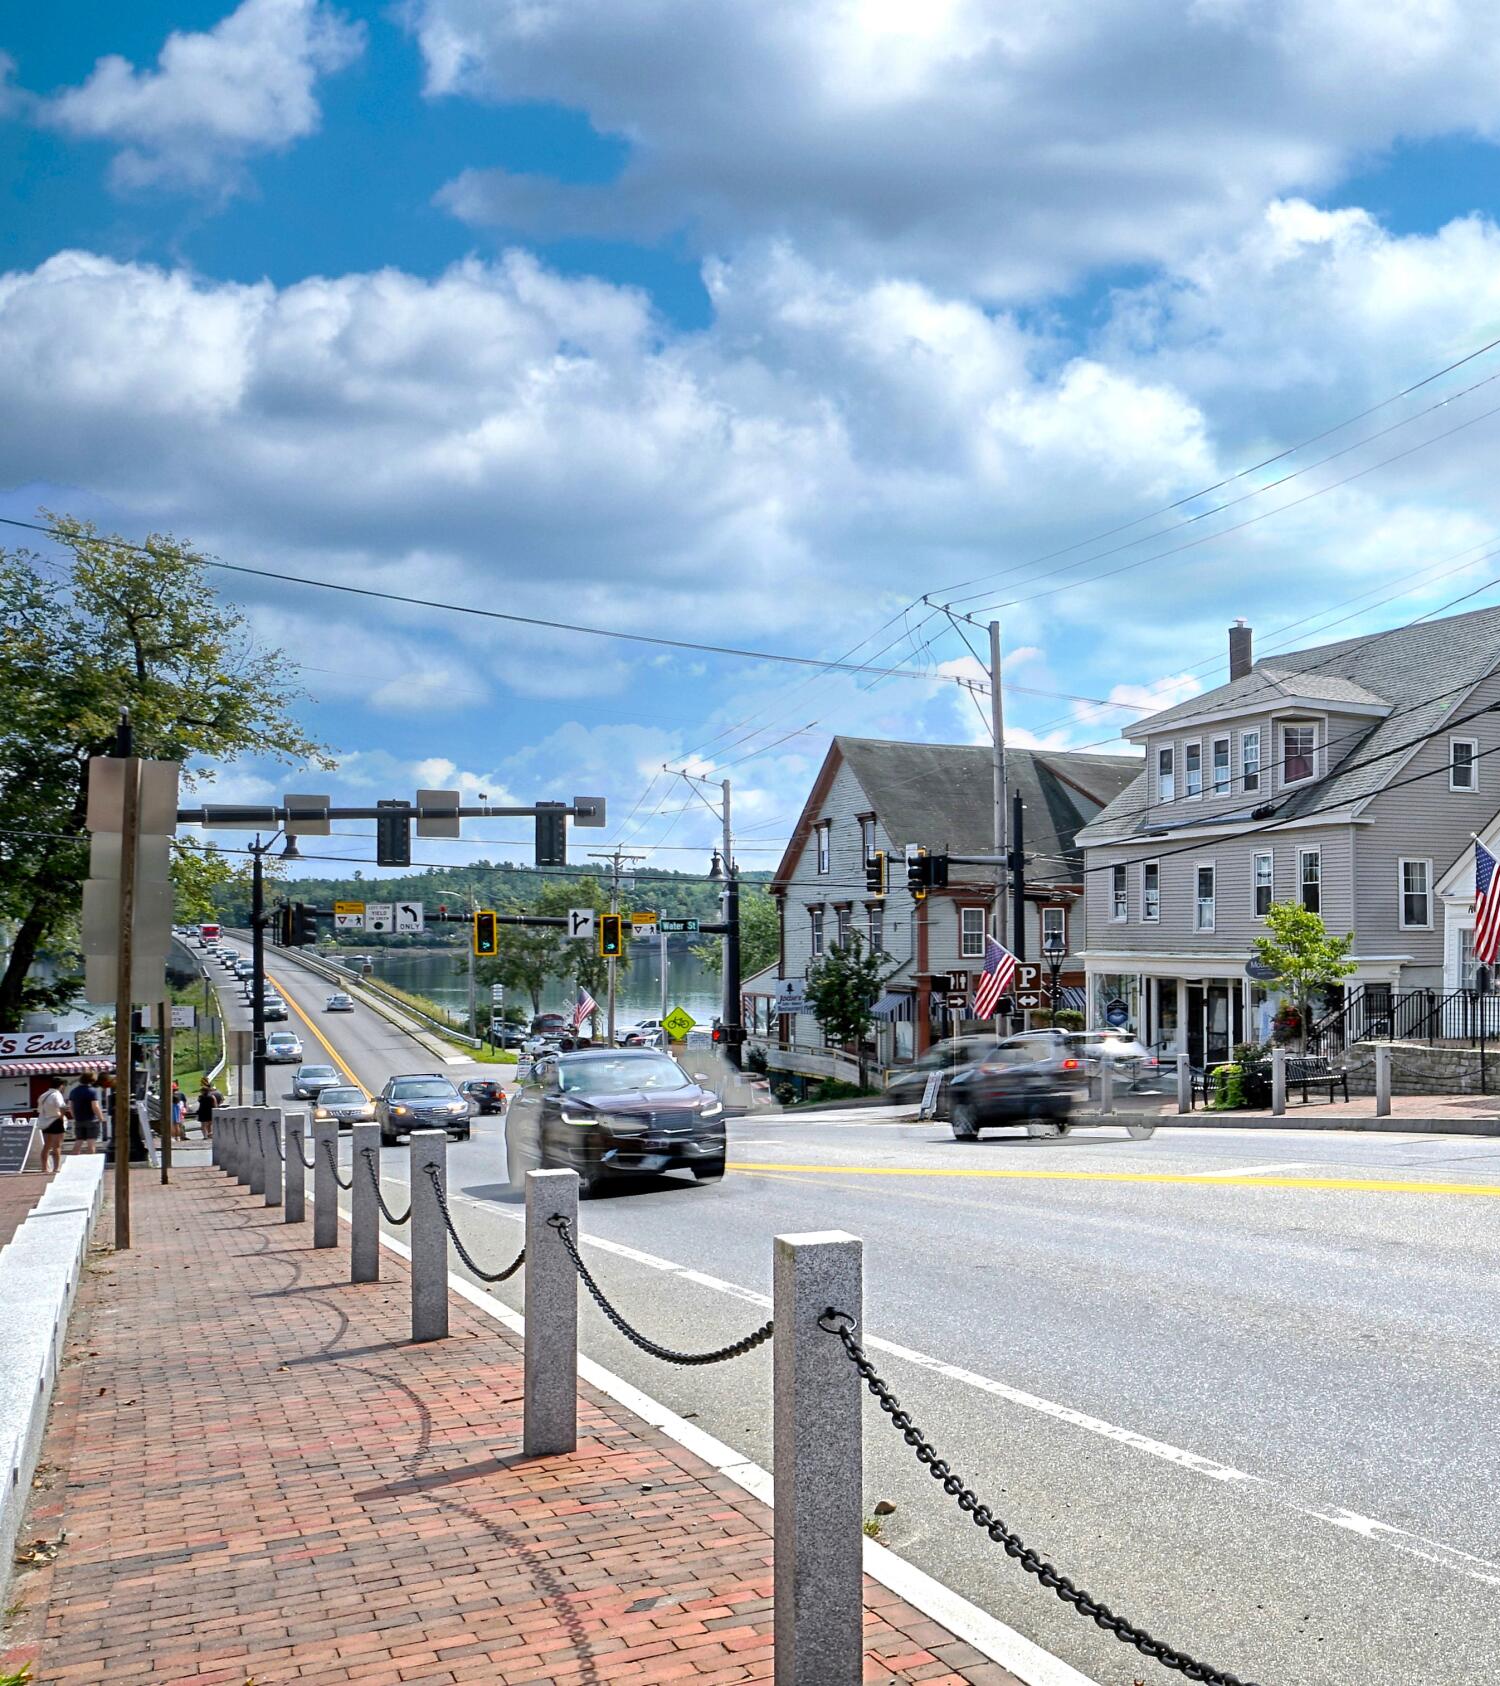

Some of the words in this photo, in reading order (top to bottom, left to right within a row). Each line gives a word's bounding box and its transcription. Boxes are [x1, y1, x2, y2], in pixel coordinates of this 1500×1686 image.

[663, 920, 684, 930] Water
[687, 920, 696, 930] St
[1019, 967, 1036, 988] P
[25, 1035, 73, 1053] Eats
